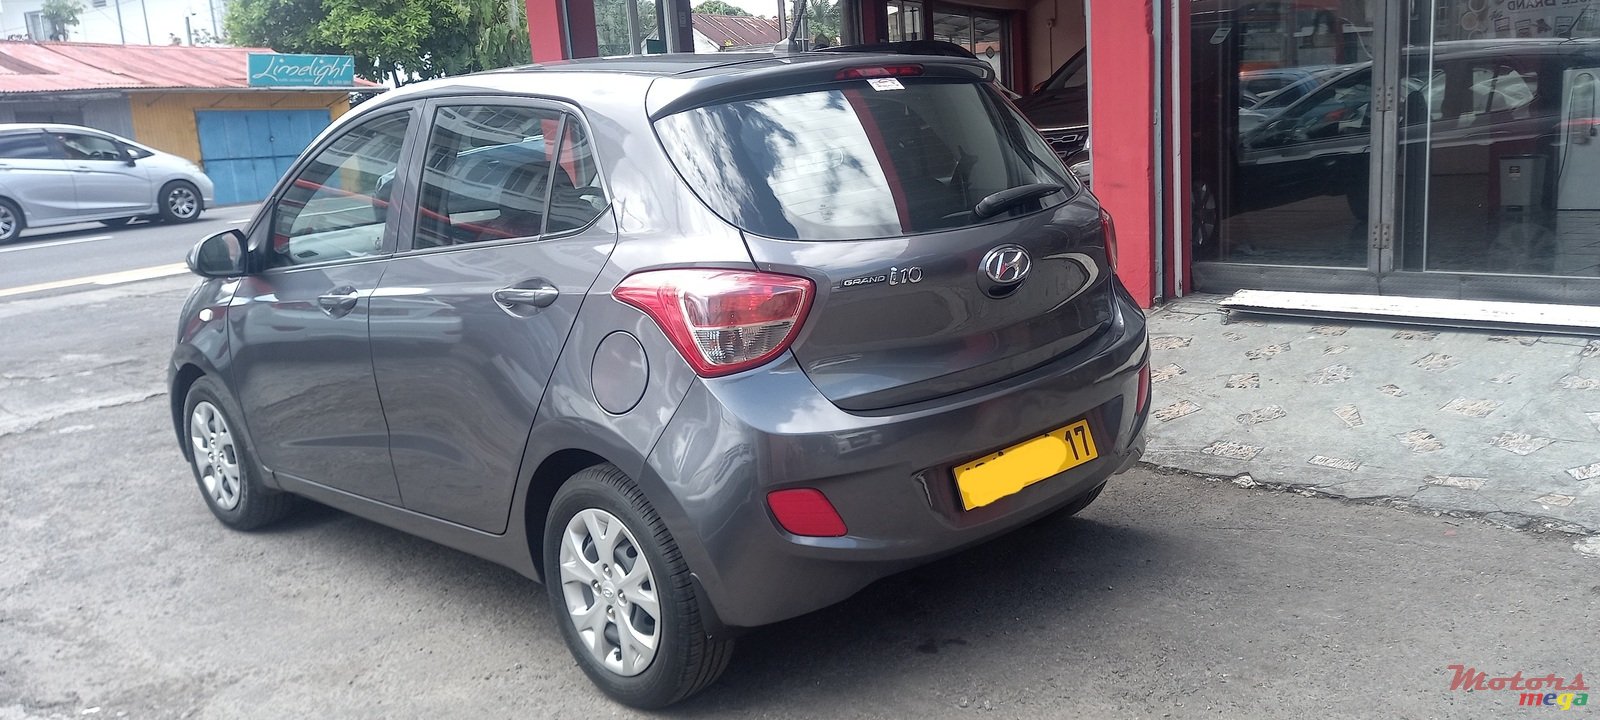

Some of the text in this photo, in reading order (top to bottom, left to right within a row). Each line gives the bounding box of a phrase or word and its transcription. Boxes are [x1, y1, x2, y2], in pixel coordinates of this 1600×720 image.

[252, 56, 351, 85] Limelight
[843, 267, 923, 286] GRAND i10
[1064, 425, 1090, 460] 17
